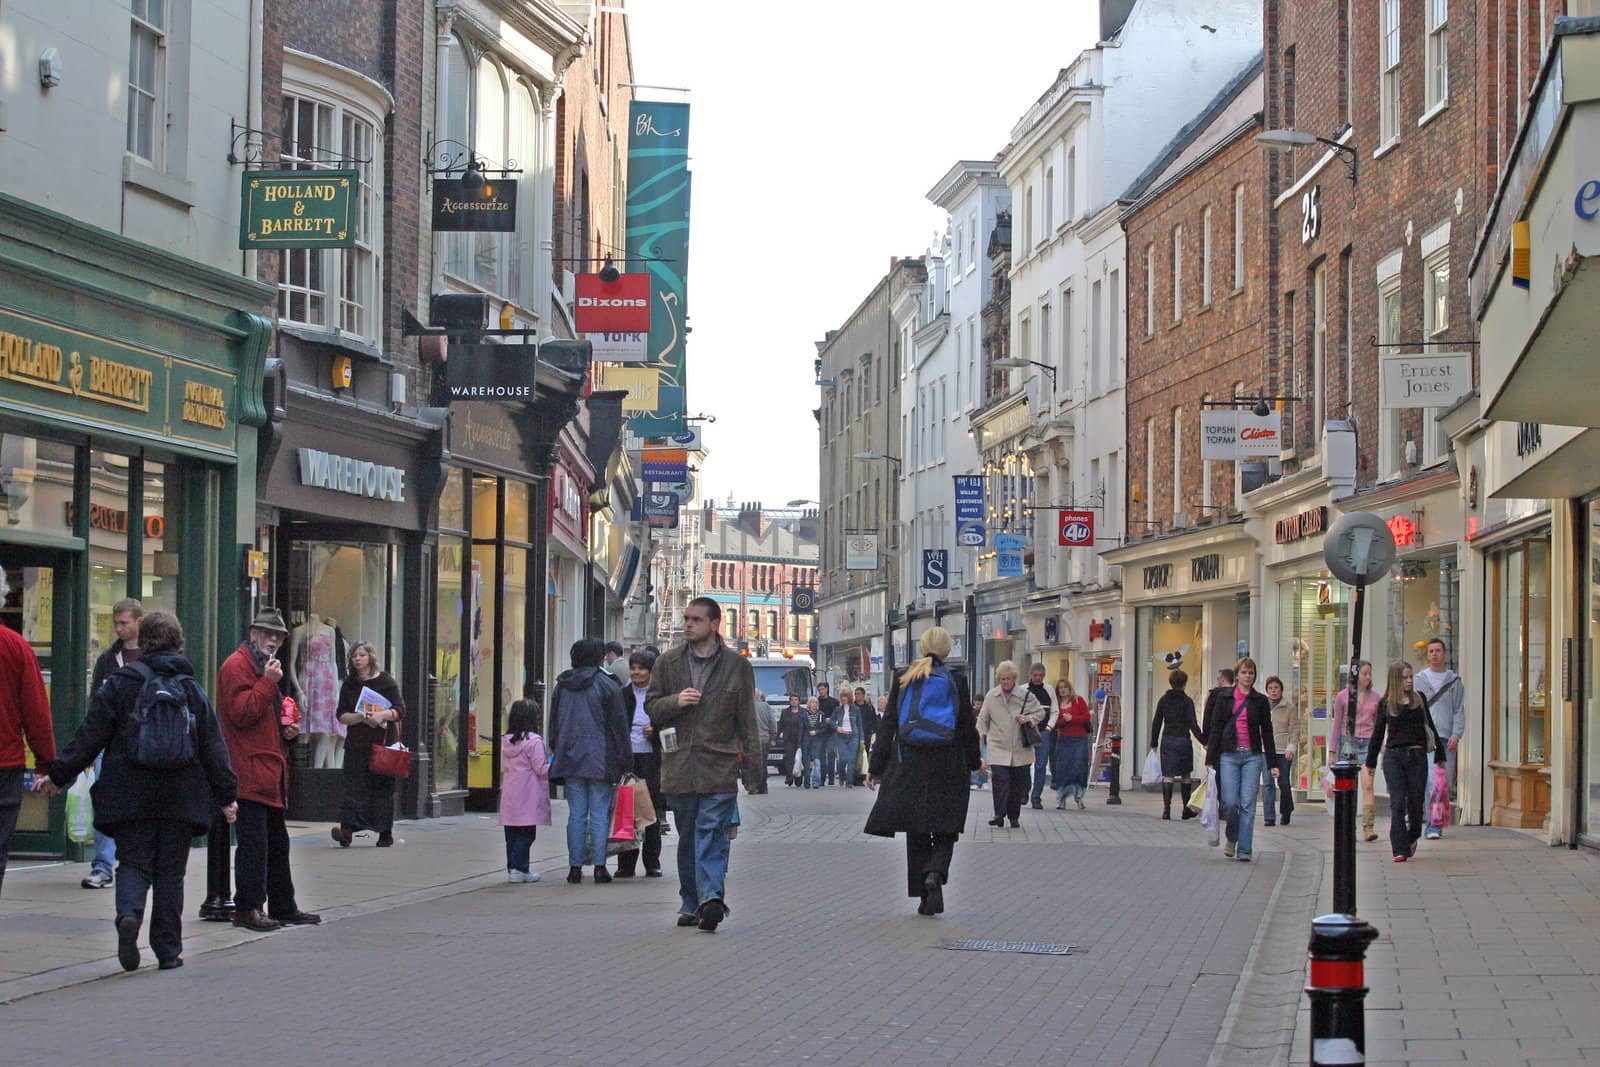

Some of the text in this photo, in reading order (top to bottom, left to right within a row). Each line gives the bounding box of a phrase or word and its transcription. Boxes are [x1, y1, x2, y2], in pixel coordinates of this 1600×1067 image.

[636, 113, 681, 137] Bhs
[264, 185, 336, 202] HOLLAND
[293, 200, 305, 217] &
[441, 197, 509, 214] Accessorize
[1302, 185, 1321, 247] 25
[261, 218, 336, 235] BARRETT
[578, 297, 647, 308] Dixons
[603, 332, 641, 343] York
[0, 331, 153, 412] HOLLAND & BARRETT
[1400, 363, 1453, 378] Ernest
[184, 380, 225, 408] NATURAL
[451, 386, 530, 396] WAREHOUSE
[1403, 379, 1450, 398] Jones
[182, 401, 226, 430] REMEDIES
[298, 447, 406, 502] WAREHOUSE
[1064, 515, 1089, 523] phones
[927, 552, 944, 560] WH
[927, 560, 945, 586] S
[1191, 553, 1220, 583] TOPMAN
[1142, 563, 1173, 592] TOPSHOP
